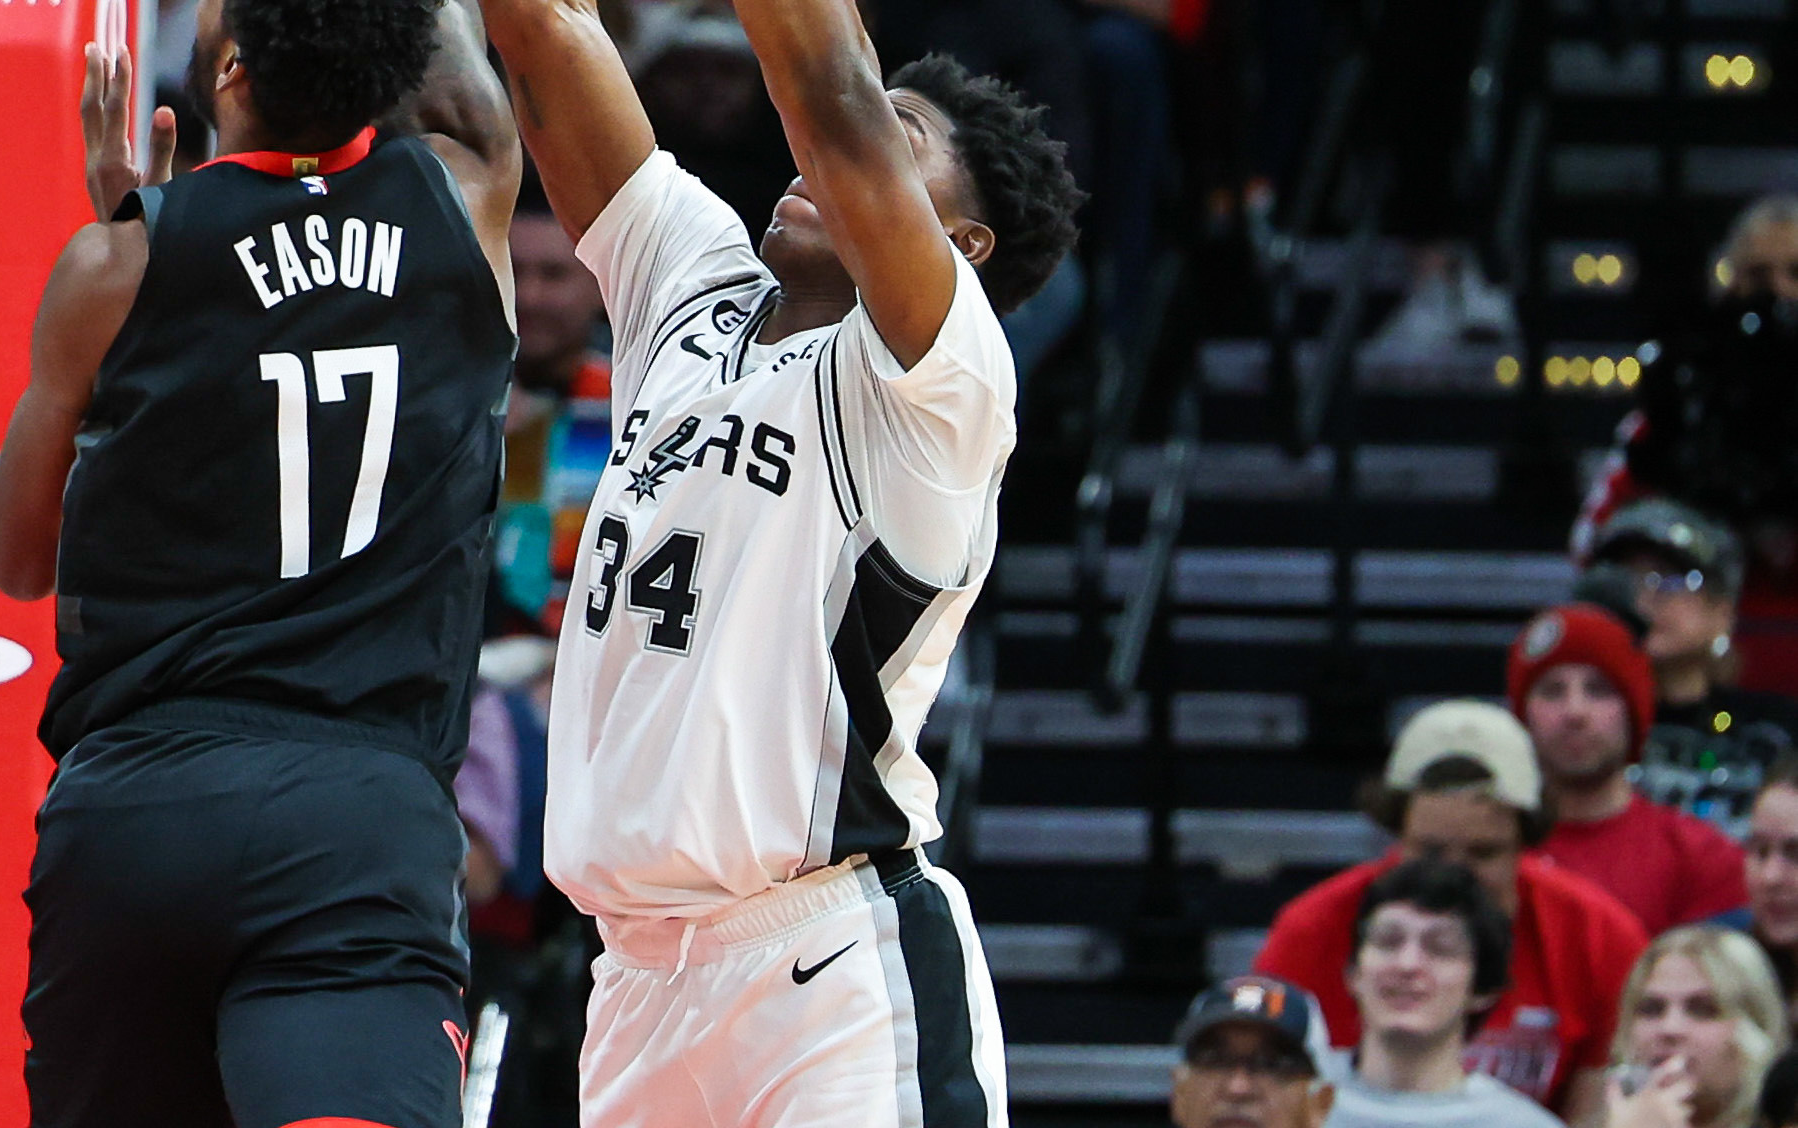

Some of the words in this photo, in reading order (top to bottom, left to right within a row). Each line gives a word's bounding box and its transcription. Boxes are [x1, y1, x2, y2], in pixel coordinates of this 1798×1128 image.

[233, 214, 403, 309] EASON
[259, 345, 400, 579] 17
[585, 511, 705, 658] 34
